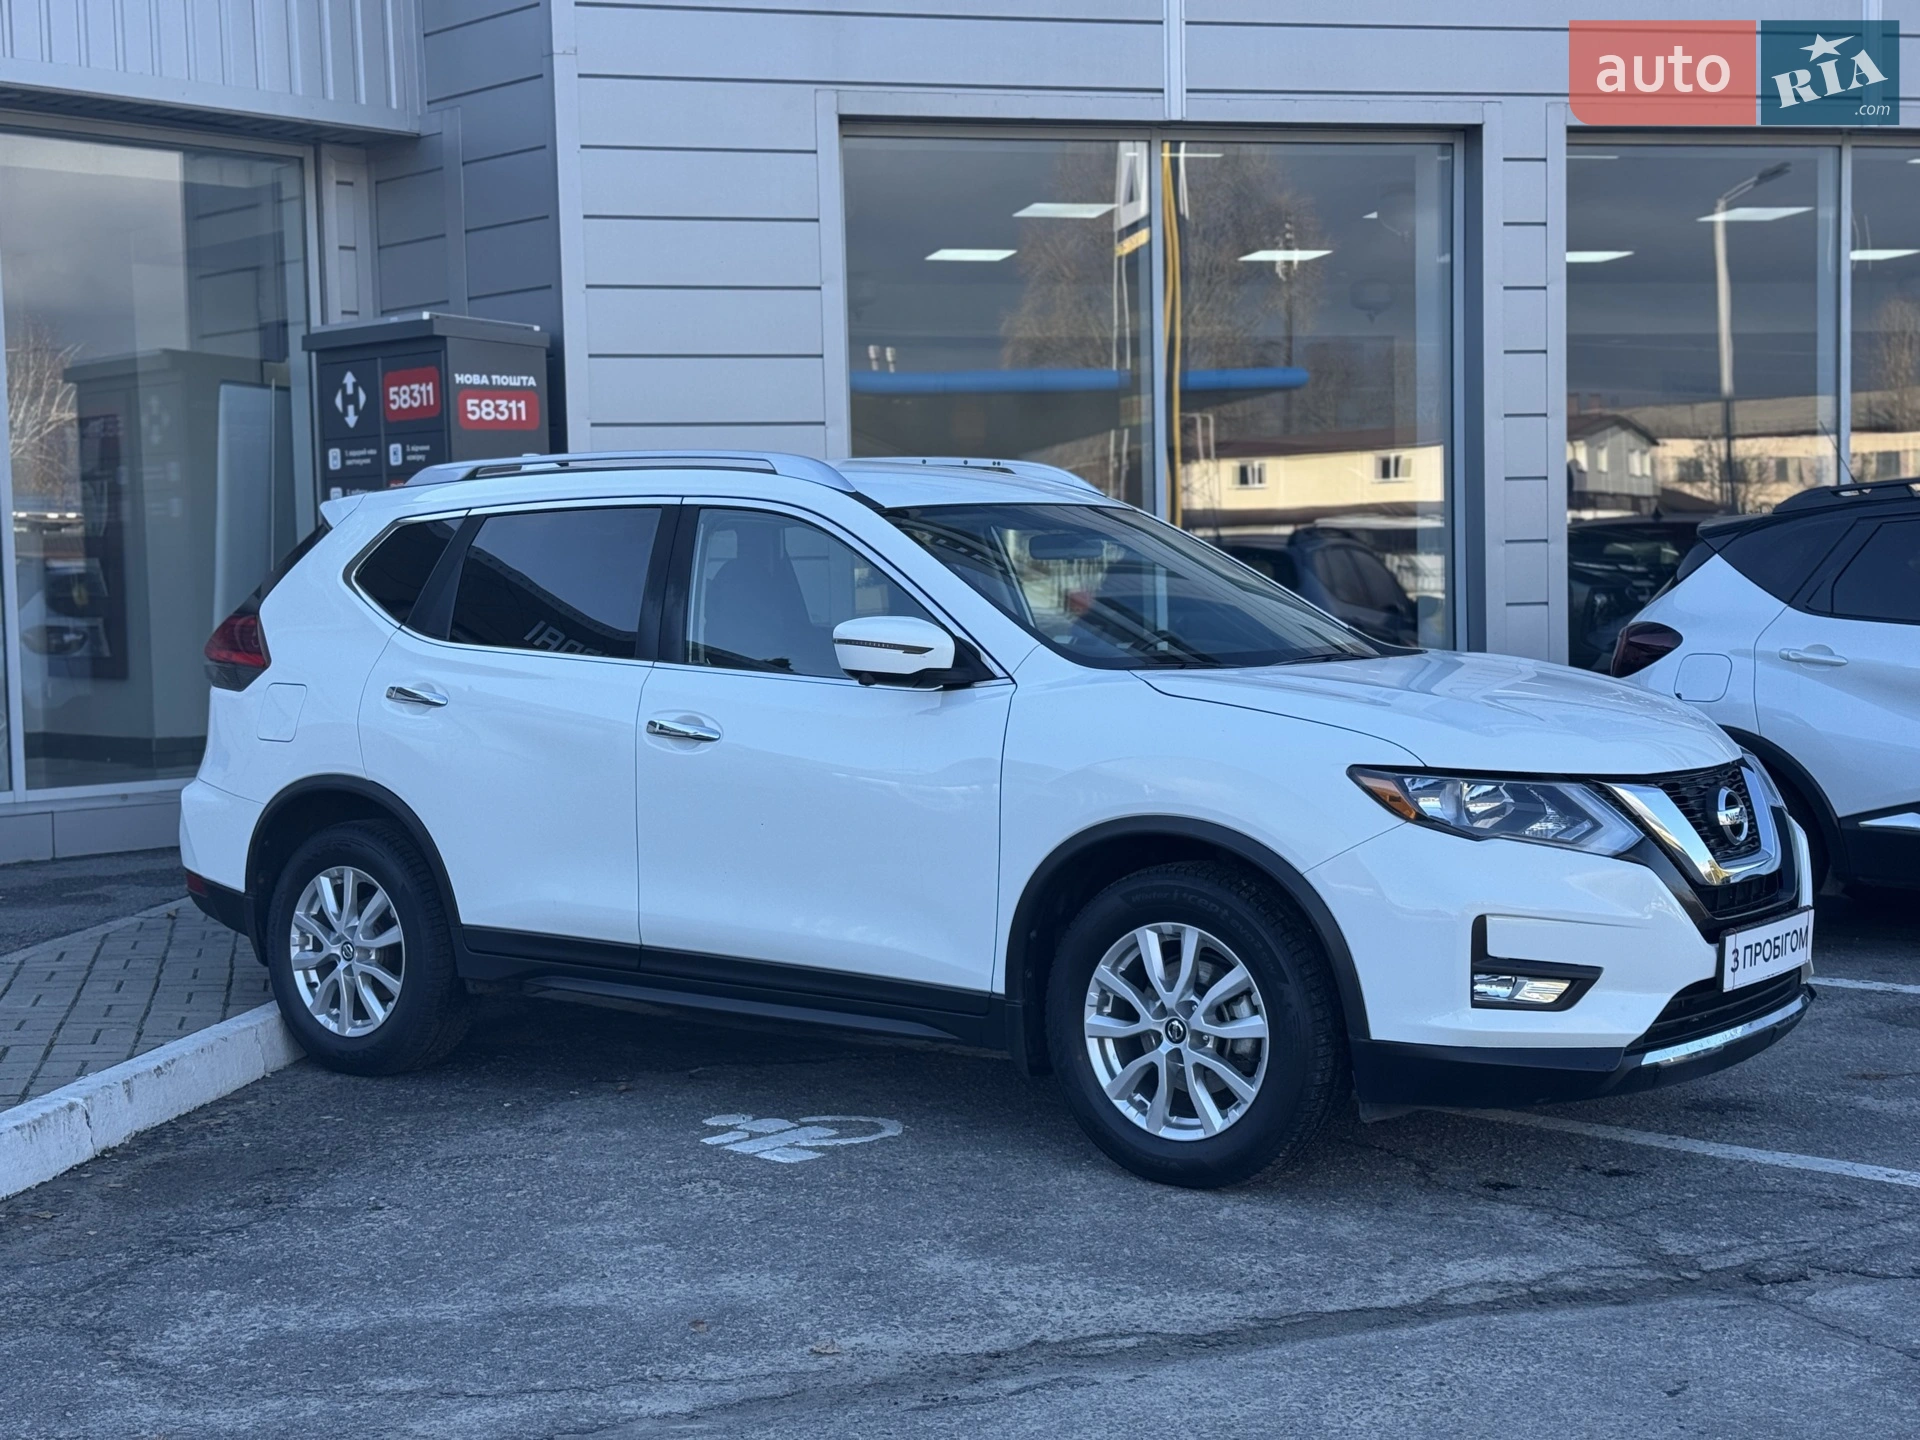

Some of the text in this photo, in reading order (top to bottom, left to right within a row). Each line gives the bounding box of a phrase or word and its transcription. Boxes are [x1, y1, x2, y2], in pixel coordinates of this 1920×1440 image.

[454, 373, 537, 387] НОВА ПОШТА
[388, 382, 434, 410] 58311
[466, 399, 527, 421] 58311
[1743, 925, 1808, 969] ПРОБІГОМ
